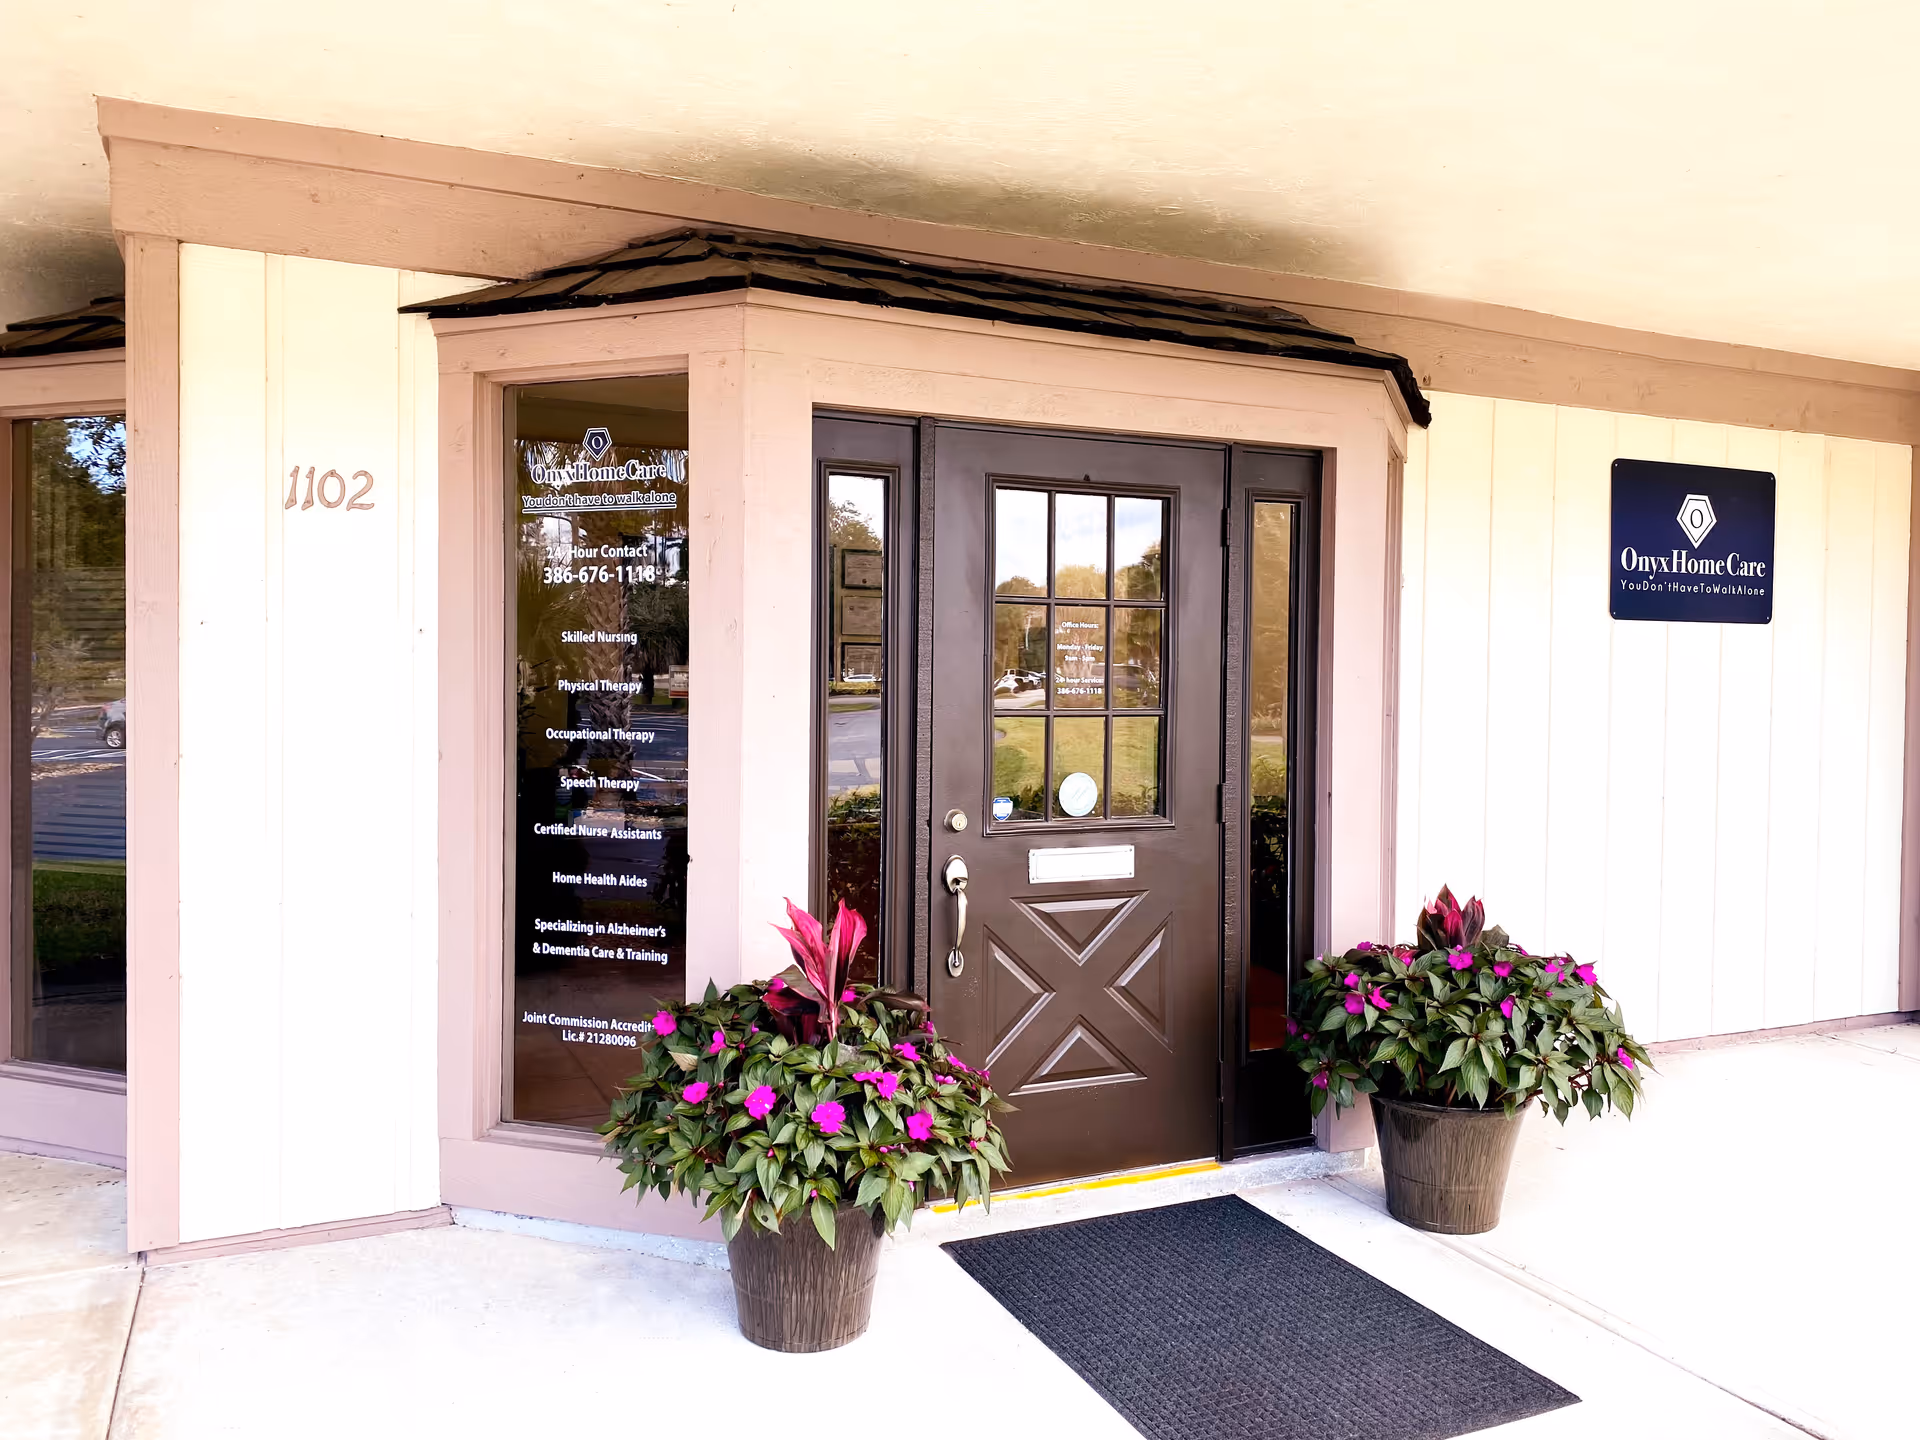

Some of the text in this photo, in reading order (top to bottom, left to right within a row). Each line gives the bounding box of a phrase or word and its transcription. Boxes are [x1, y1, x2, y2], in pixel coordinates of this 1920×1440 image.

[284, 465, 375, 511] 1102
[522, 490, 677, 508] You don't have to walk alone
[569, 546, 598, 558] Hour
[600, 545, 648, 557] Contact
[543, 565, 656, 584] 386-676-1118
[561, 631, 638, 645] Skilled Nursing
[1085, 644, 1103, 652] Friday
[558, 680, 642, 693] Physical Therapy
[546, 728, 655, 743] Occupational Therapy
[560, 776, 640, 791] Speech Therapy
[534, 823, 662, 840] Certified Nurse Assistants
[552, 872, 648, 887] Home Health Aides
[534, 919, 666, 937] Specializing in Alzheimer's
[532, 942, 668, 965] & Dementia Care & Training
[522, 1011, 547, 1024] Joint
[548, 1013, 608, 1030] Commission
[562, 1029, 637, 1047] Lic.# 21280096
